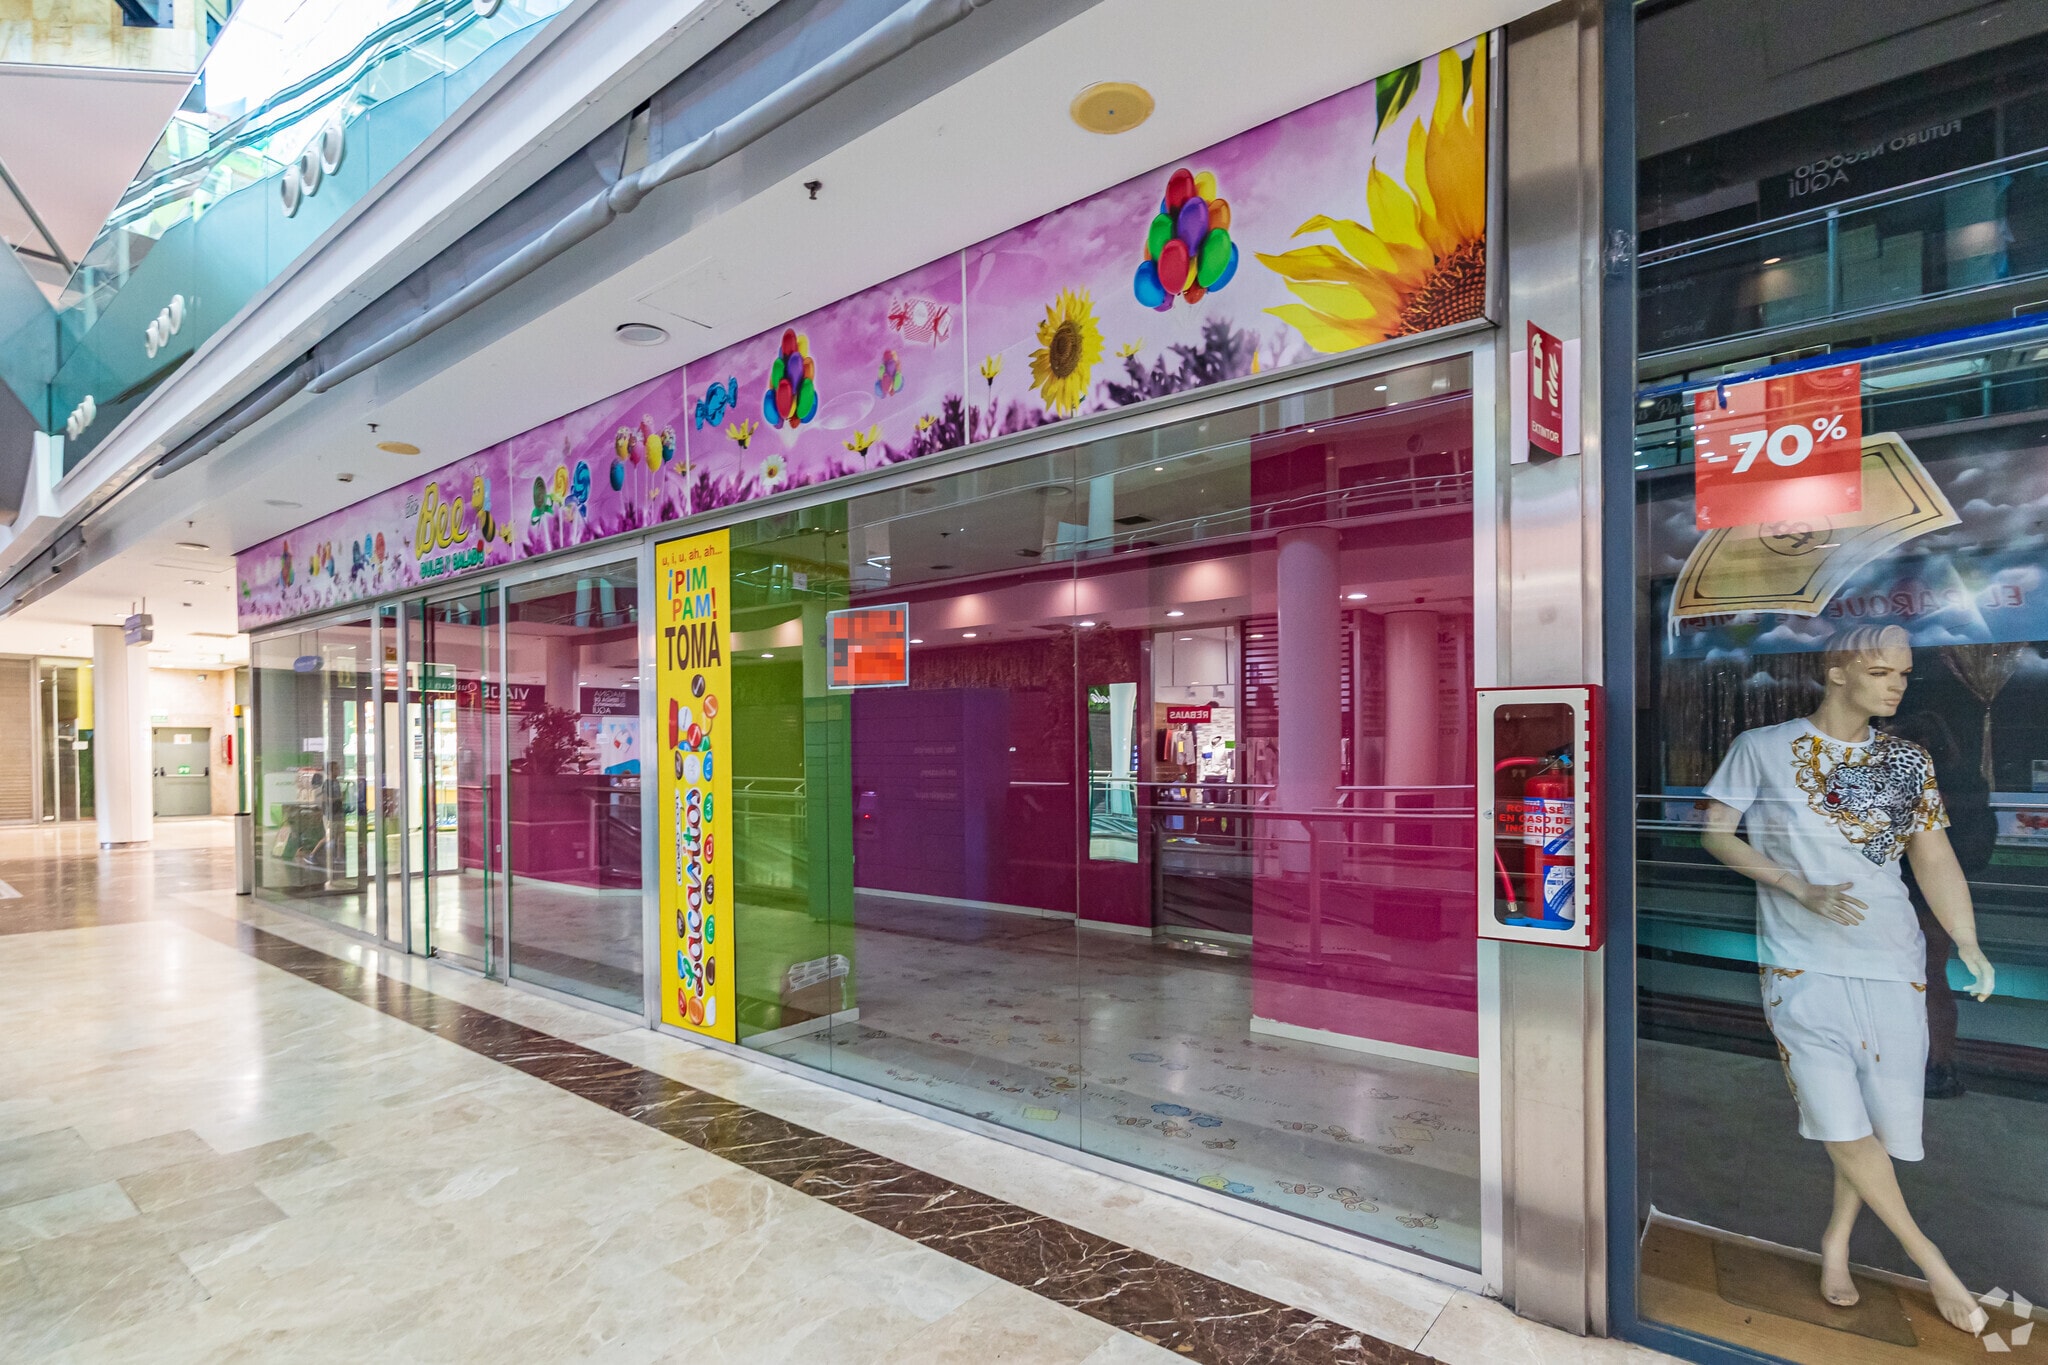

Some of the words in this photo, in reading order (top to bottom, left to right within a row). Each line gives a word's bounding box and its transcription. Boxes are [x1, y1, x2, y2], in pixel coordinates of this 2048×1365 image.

[1531, 420, 1559, 443] EXTINTOR
[1708, 414, 1847, 474] -70%
[414, 481, 469, 561] Bee
[688, 548, 702, 561] ah,
[668, 565, 707, 600] ¡PIM
[672, 587, 717, 622] PAM!
[665, 620, 722, 671] TOMA
[1499, 814, 1515, 822] EN
[1519, 814, 1552, 824] CASO
[1555, 816, 1572, 825] DE
[1505, 804, 1565, 815] ROMPASE
[1505, 824, 1565, 835] INCENDIO
[683, 788, 705, 998] Lacasitos
